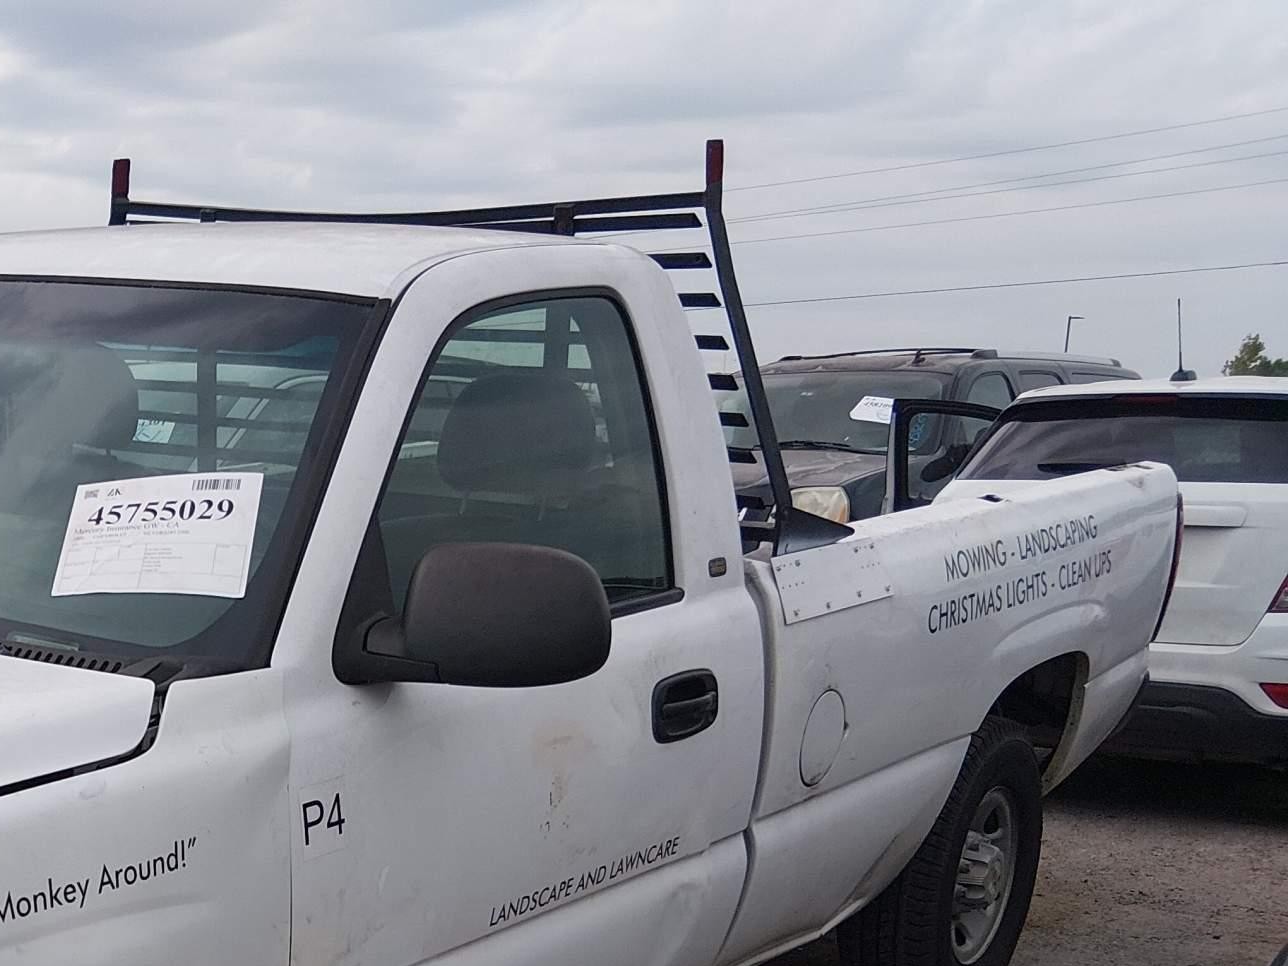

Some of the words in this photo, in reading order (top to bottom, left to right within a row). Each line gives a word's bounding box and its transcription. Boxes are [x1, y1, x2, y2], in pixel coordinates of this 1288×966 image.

[87, 498, 235, 526] 45755029
[944, 539, 1007, 583] MOWING
[1016, 514, 1098, 561] LANDSCAPING
[927, 584, 1003, 634] CHRISTMAS
[1006, 571, 1048, 609] LIGHTS
[1058, 556, 1092, 591] CLEAN
[1094, 550, 1112, 579] UPS
[301, 792, 346, 846] P4
[488, 877, 575, 928] LANDSCAPE
[575, 864, 607, 893] AND
[608, 836, 681, 880] LAWNCARE
